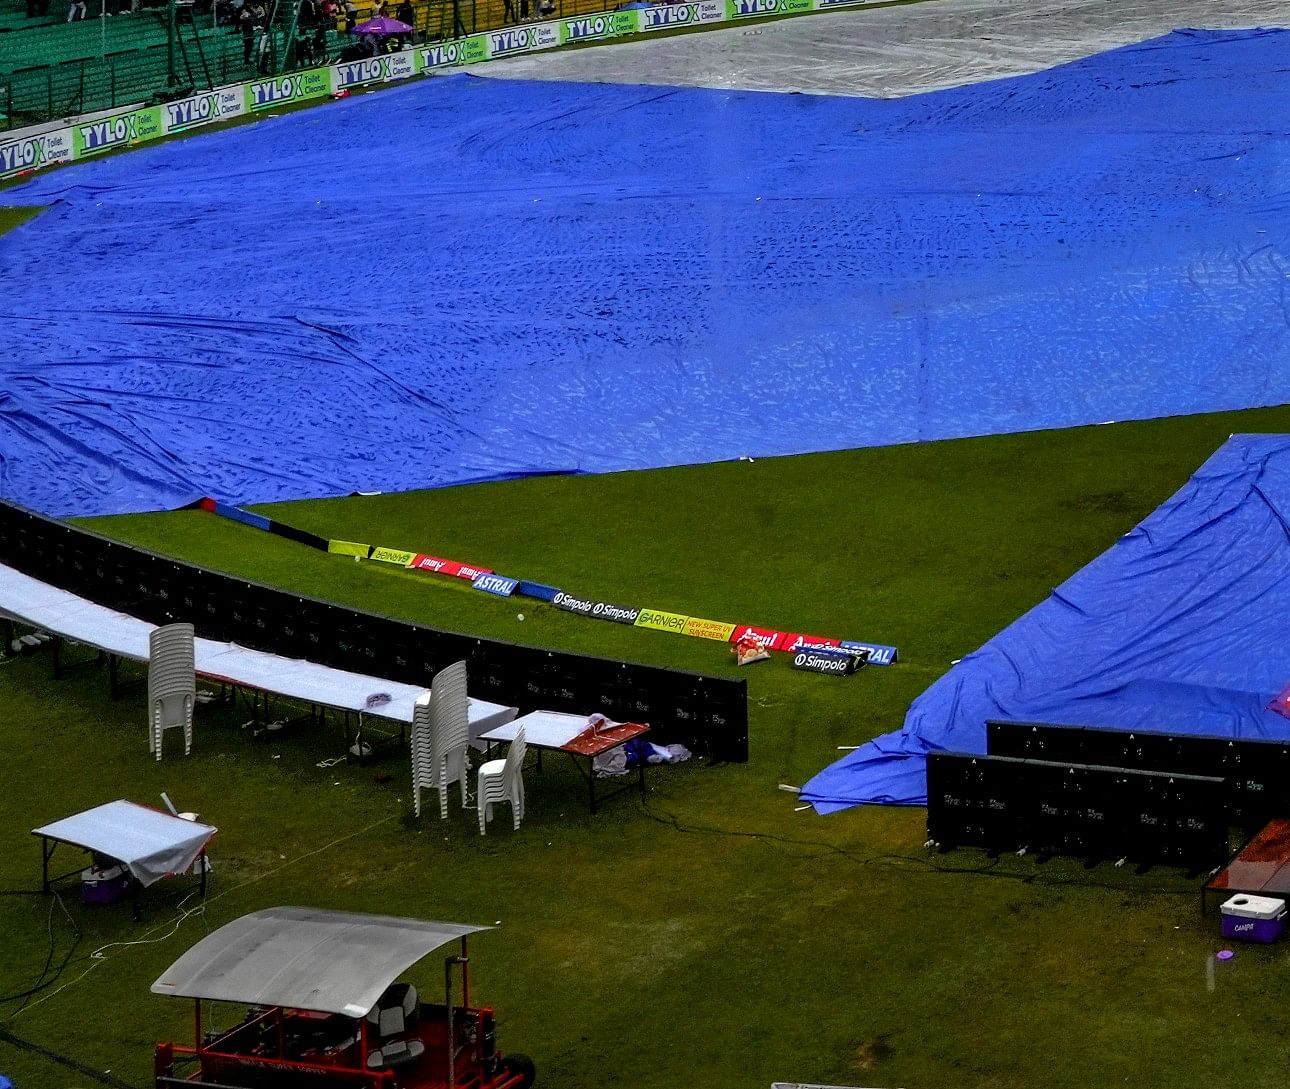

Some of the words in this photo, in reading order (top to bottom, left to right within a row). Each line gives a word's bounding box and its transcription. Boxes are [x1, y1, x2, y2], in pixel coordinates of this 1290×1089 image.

[646, 2, 700, 26] TYLOX
[492, 27, 537, 52] TYLOX
[338, 57, 391, 84] TYLOX
[251, 72, 303, 105] TYLOX
[168, 94, 219, 124] TYLOX
[138, 114, 152, 125] Toilet
[81, 114, 137, 148] TYLOX
[138, 123, 158, 135] Cleaner
[420, 557, 446, 572] Amul
[475, 575, 514, 594] ASTRAL
[562, 594, 592, 612] Simpolo
[602, 603, 638, 620] Simpolo
[639, 611, 685, 629] GARNIER
[687, 620, 701, 628] NEW
[703, 622, 721, 631] SUPER
[688, 628, 724, 640] SUNSCREEN
[806, 655, 848, 672] Simpolo
